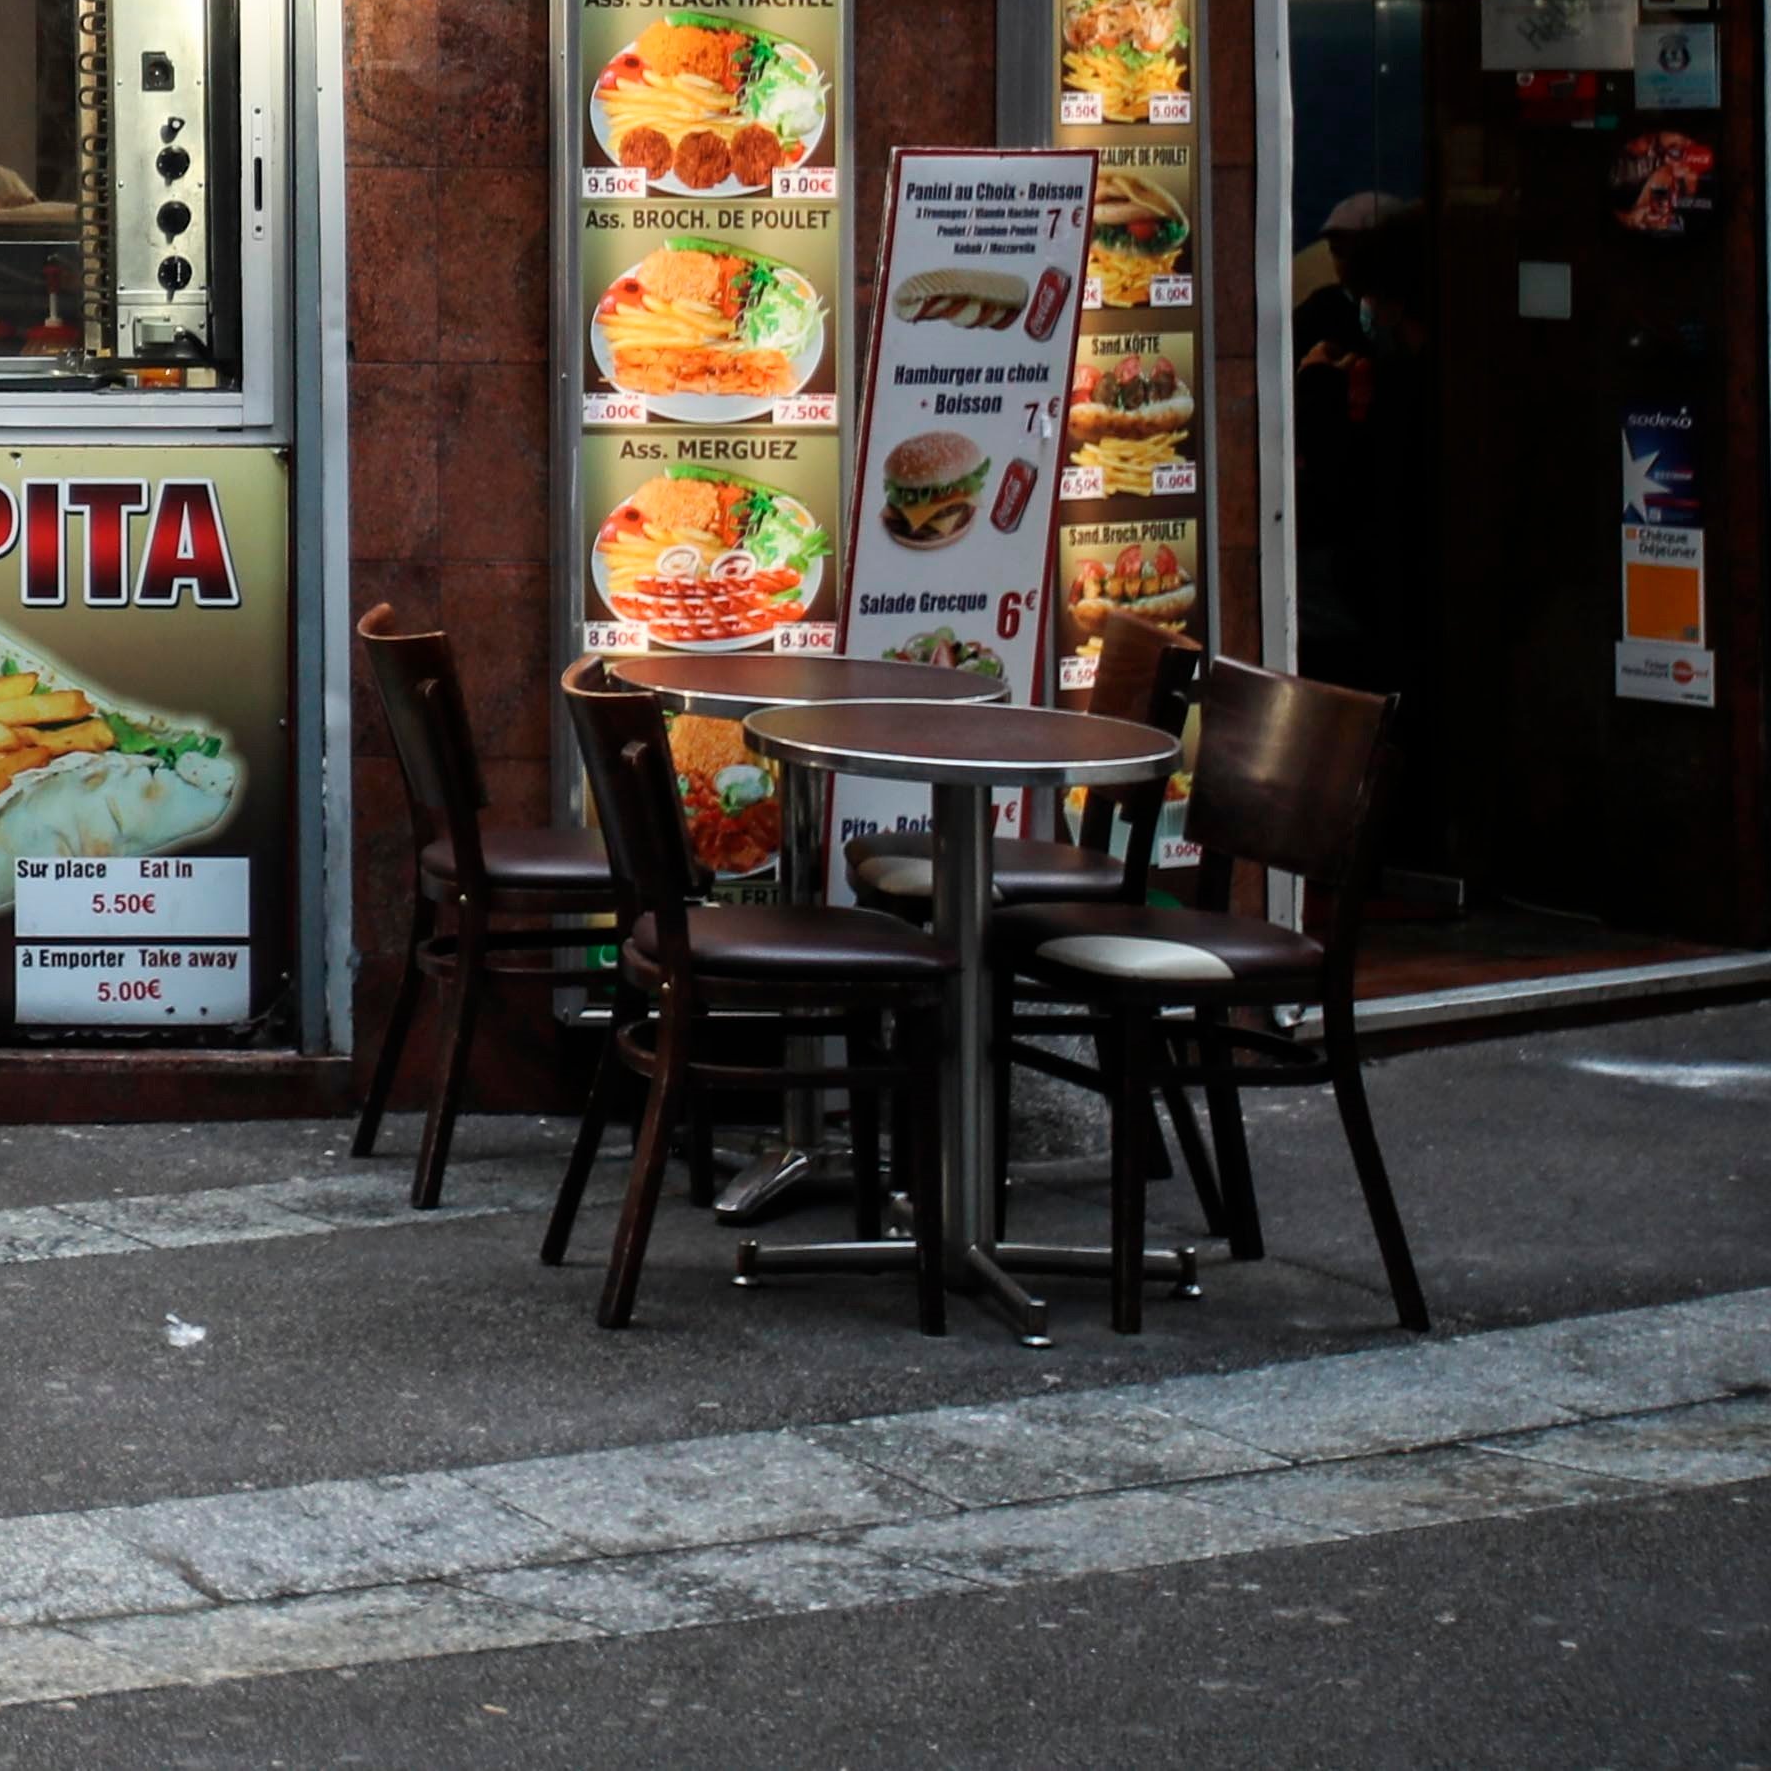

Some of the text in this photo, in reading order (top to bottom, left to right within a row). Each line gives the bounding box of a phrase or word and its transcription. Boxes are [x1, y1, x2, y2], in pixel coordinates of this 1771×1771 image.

[584, 208, 831, 230] Ass. BROCH. DE POULET
[894, 365, 1050, 387] Hamburger au choix
[933, 393, 1003, 416] Boisson
[619, 439, 798, 461] Ass. MERGUEZ
[859, 590, 1023, 641] Salade Grecque 6
[16, 859, 193, 883] Sur place Eat in
[91, 892, 157, 917] 5.50€
[21, 948, 238, 974] à Emporter Take away
[97, 979, 163, 1004] 5.00€
